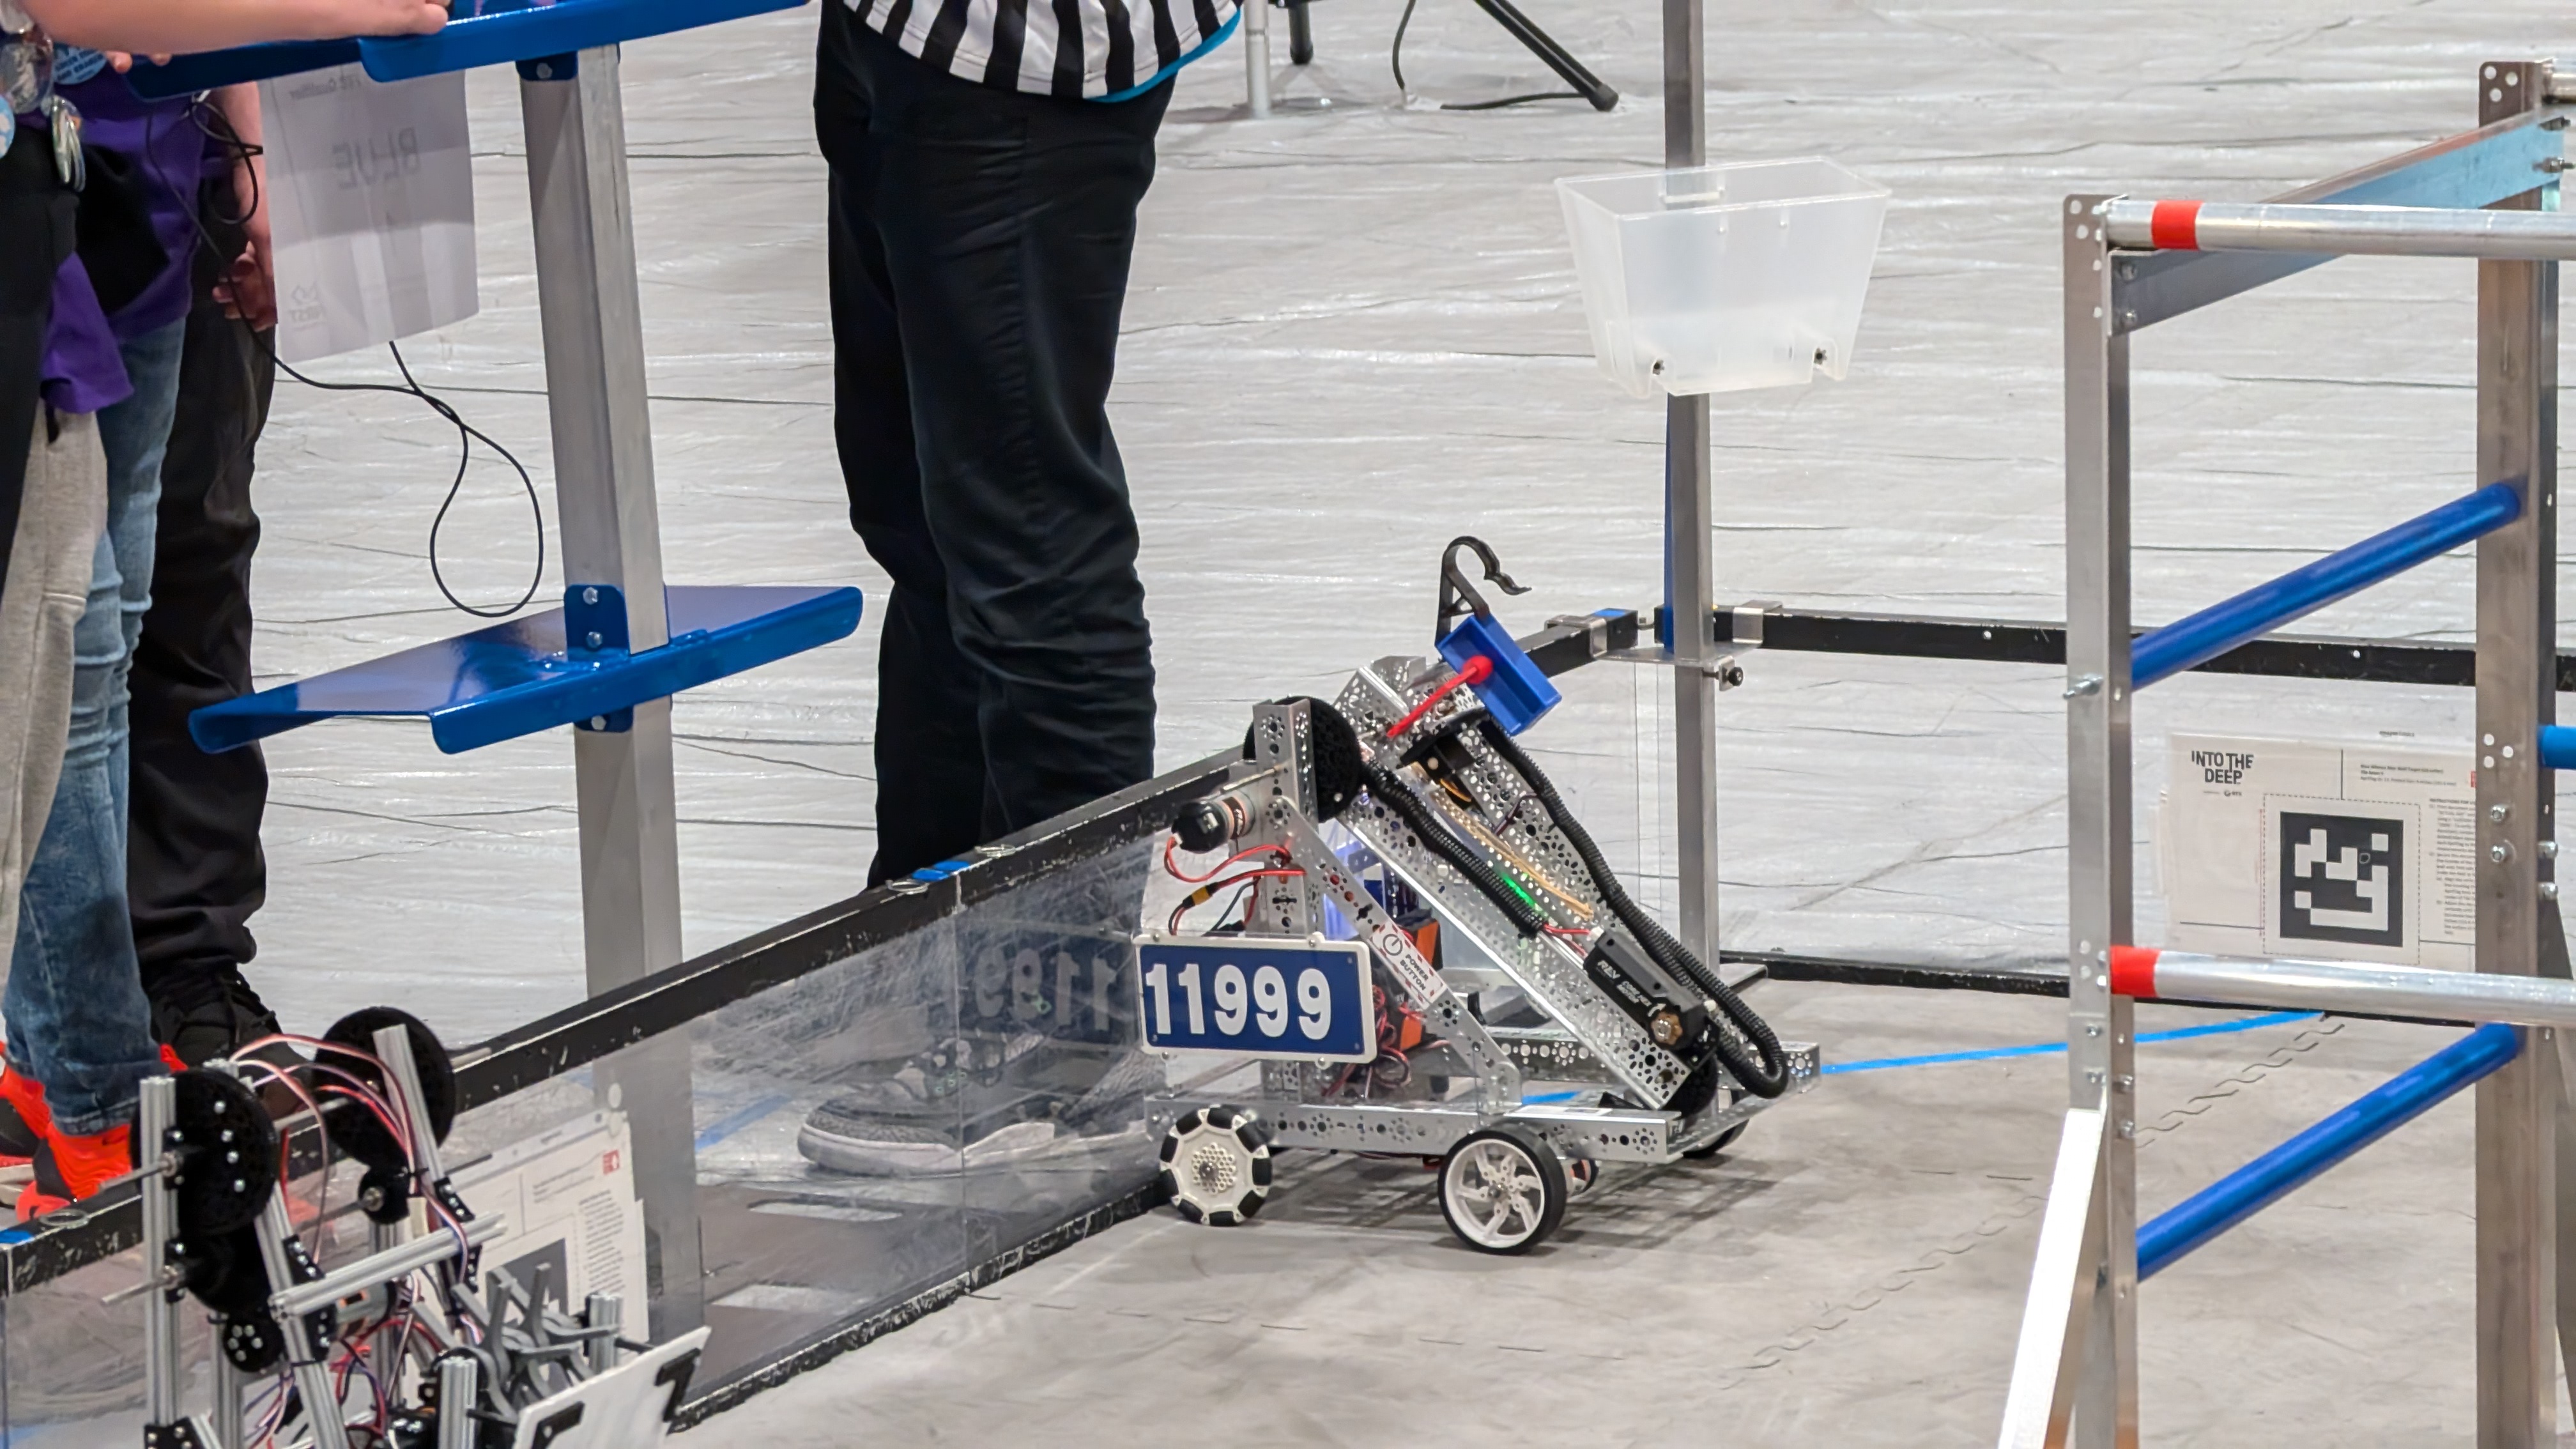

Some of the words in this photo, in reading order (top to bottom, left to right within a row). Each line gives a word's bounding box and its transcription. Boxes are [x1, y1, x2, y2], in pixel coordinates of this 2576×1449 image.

[2191, 750, 2224, 767] INTO
[2225, 753, 2254, 772] THE
[2204, 768, 2243, 785] DEEP
[1400, 960, 1426, 991] BUTTON
[1405, 954, 1429, 981] POWER
[1146, 963, 1331, 1041] 11999
